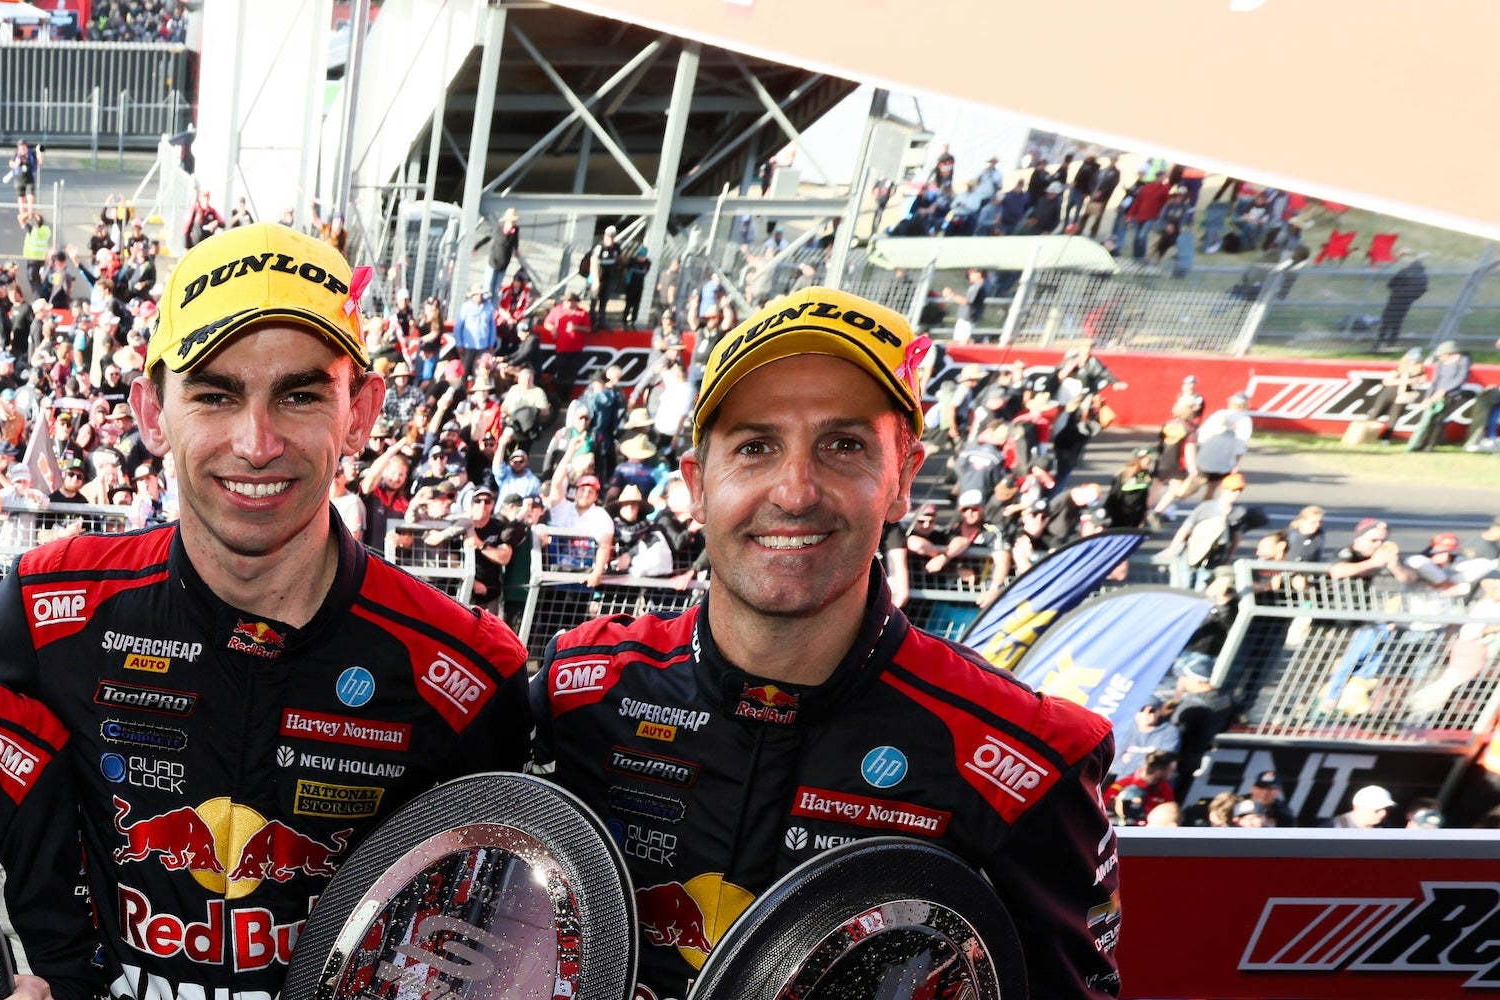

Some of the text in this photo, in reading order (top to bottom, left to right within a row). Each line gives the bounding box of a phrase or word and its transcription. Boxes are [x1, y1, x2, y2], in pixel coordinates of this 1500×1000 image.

[180, 253, 349, 308] DUNLOP
[715, 302, 902, 373] DUNLOP
[33, 595, 86, 622] OMP
[101, 631, 202, 662] SUPERCHEAP
[227, 635, 282, 659] Red Bull
[130, 657, 167, 671] AUTO
[555, 664, 607, 692] OMP
[342, 671, 371, 704] hp
[428, 661, 481, 706] OMP
[101, 686, 189, 711] ToolPRO
[735, 701, 797, 724] Red Bull
[619, 697, 711, 731] SUPERCHEAP
[286, 714, 405, 743] Harvey Norman
[641, 725, 672, 739] AUTO
[129, 756, 184, 778] QUAD
[300, 752, 406, 778] NEW HOLLAND
[871, 746, 902, 781] hp
[974, 743, 1040, 790] OMP
[129, 771, 185, 794] LOCK
[300, 781, 380, 801] NATIONAL
[301, 798, 375, 817] STORAGE
[799, 793, 939, 830] Harvey Norman
[628, 824, 677, 850] QUAD
[625, 839, 676, 867] LOCK
[117, 882, 318, 974] Red Bu
